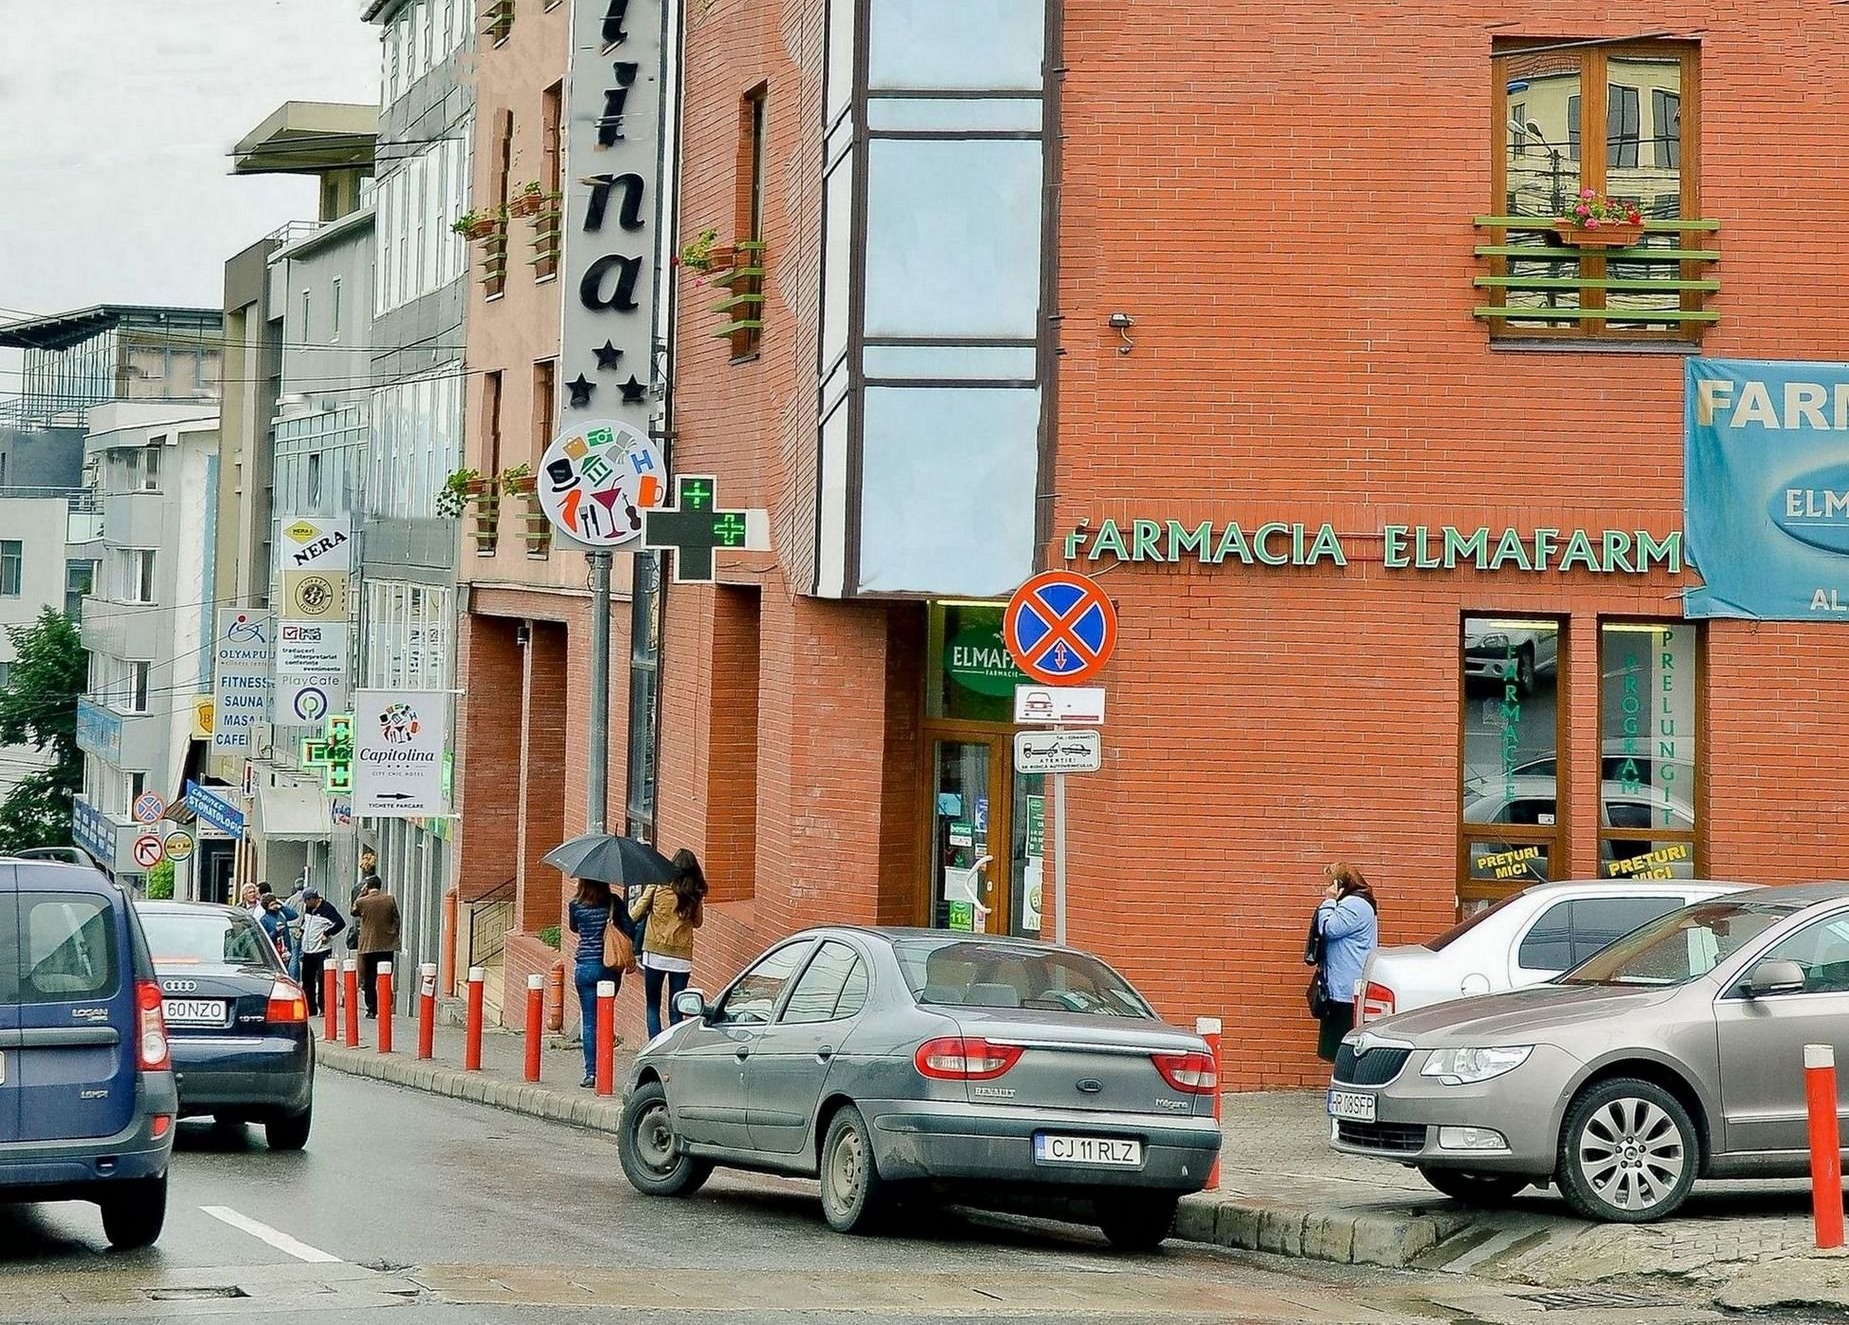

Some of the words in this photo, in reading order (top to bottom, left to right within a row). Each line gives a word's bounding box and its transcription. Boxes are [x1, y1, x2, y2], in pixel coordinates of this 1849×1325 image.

[293, 531, 348, 566] NERA
[1064, 518, 1347, 566] FARMACIA
[1383, 524, 1684, 574] ELMAFARM
[219, 649, 268, 660] OLYMPU
[282, 676, 340, 687] PlayCafe
[225, 696, 264, 707] SAUNA
[1620, 652, 1642, 795] PROGRAM
[1659, 630, 1675, 826] PRELUNGIT
[360, 747, 435, 763] Capitolina
[1495, 862, 1527, 879] MICI
[72, 1008, 108, 1017] LOGAN
[974, 1087, 1016, 1098] RENAULT
[1052, 1139, 1074, 1158] CJ
[1080, 1141, 1093, 1159] 11
[1098, 1142, 1134, 1162] RLZ
